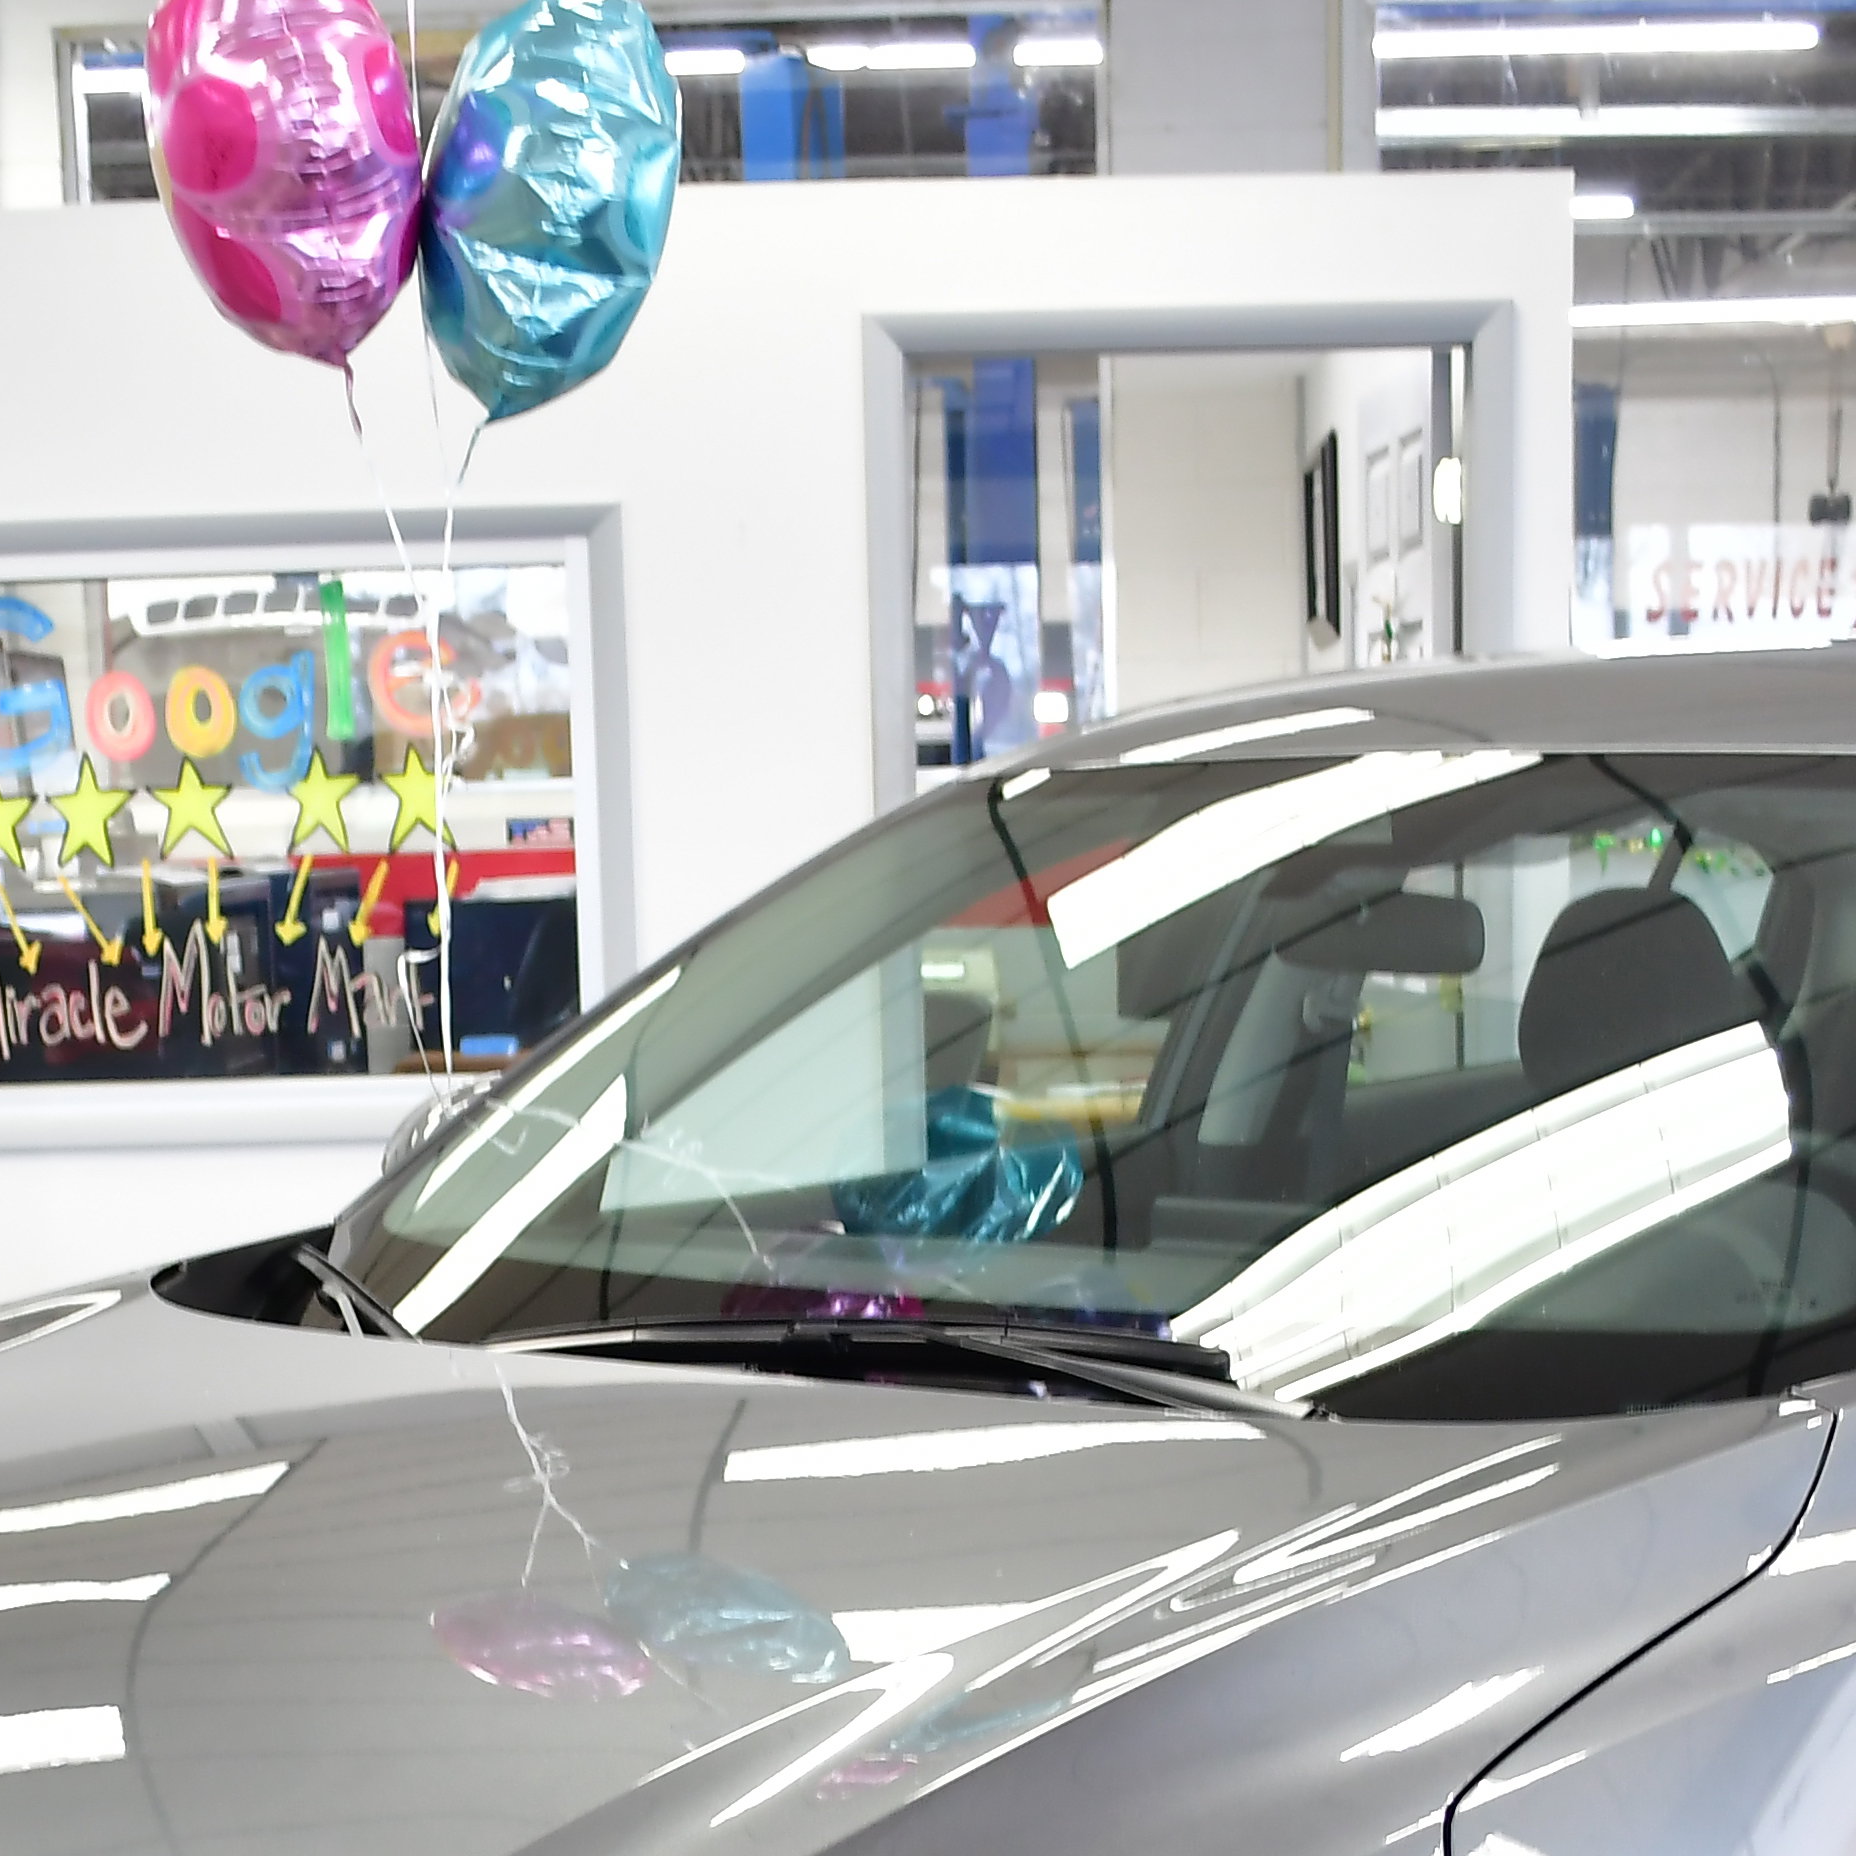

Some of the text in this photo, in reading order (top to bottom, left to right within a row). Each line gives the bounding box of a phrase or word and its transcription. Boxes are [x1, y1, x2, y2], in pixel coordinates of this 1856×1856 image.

[1646, 557, 1837, 623] SERVICE
[158, 918, 291, 1047] Motor
[307, 935, 434, 1038] Mart
